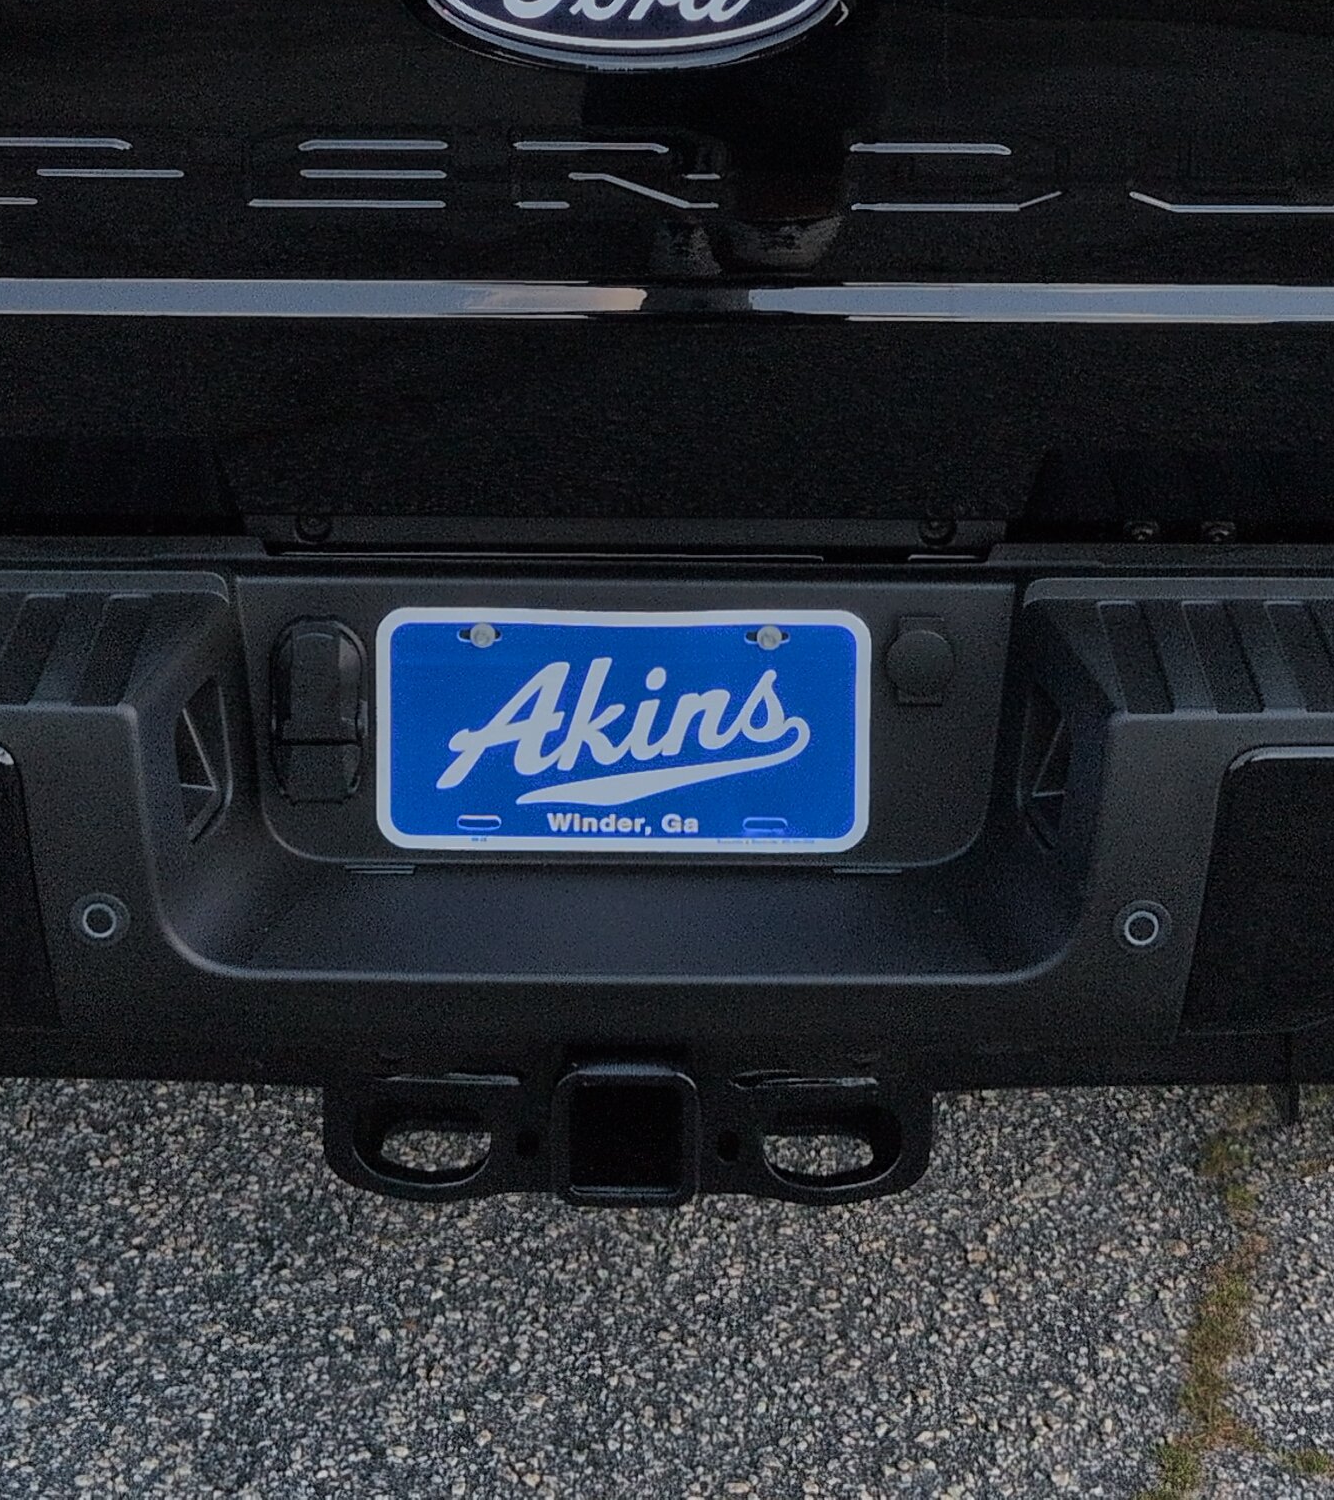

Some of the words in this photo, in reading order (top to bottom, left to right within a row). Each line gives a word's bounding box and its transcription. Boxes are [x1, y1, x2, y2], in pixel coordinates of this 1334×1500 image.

[436, 657, 810, 806] Akins
[547, 813, 652, 835] Winder,
[661, 814, 699, 834] Ga
